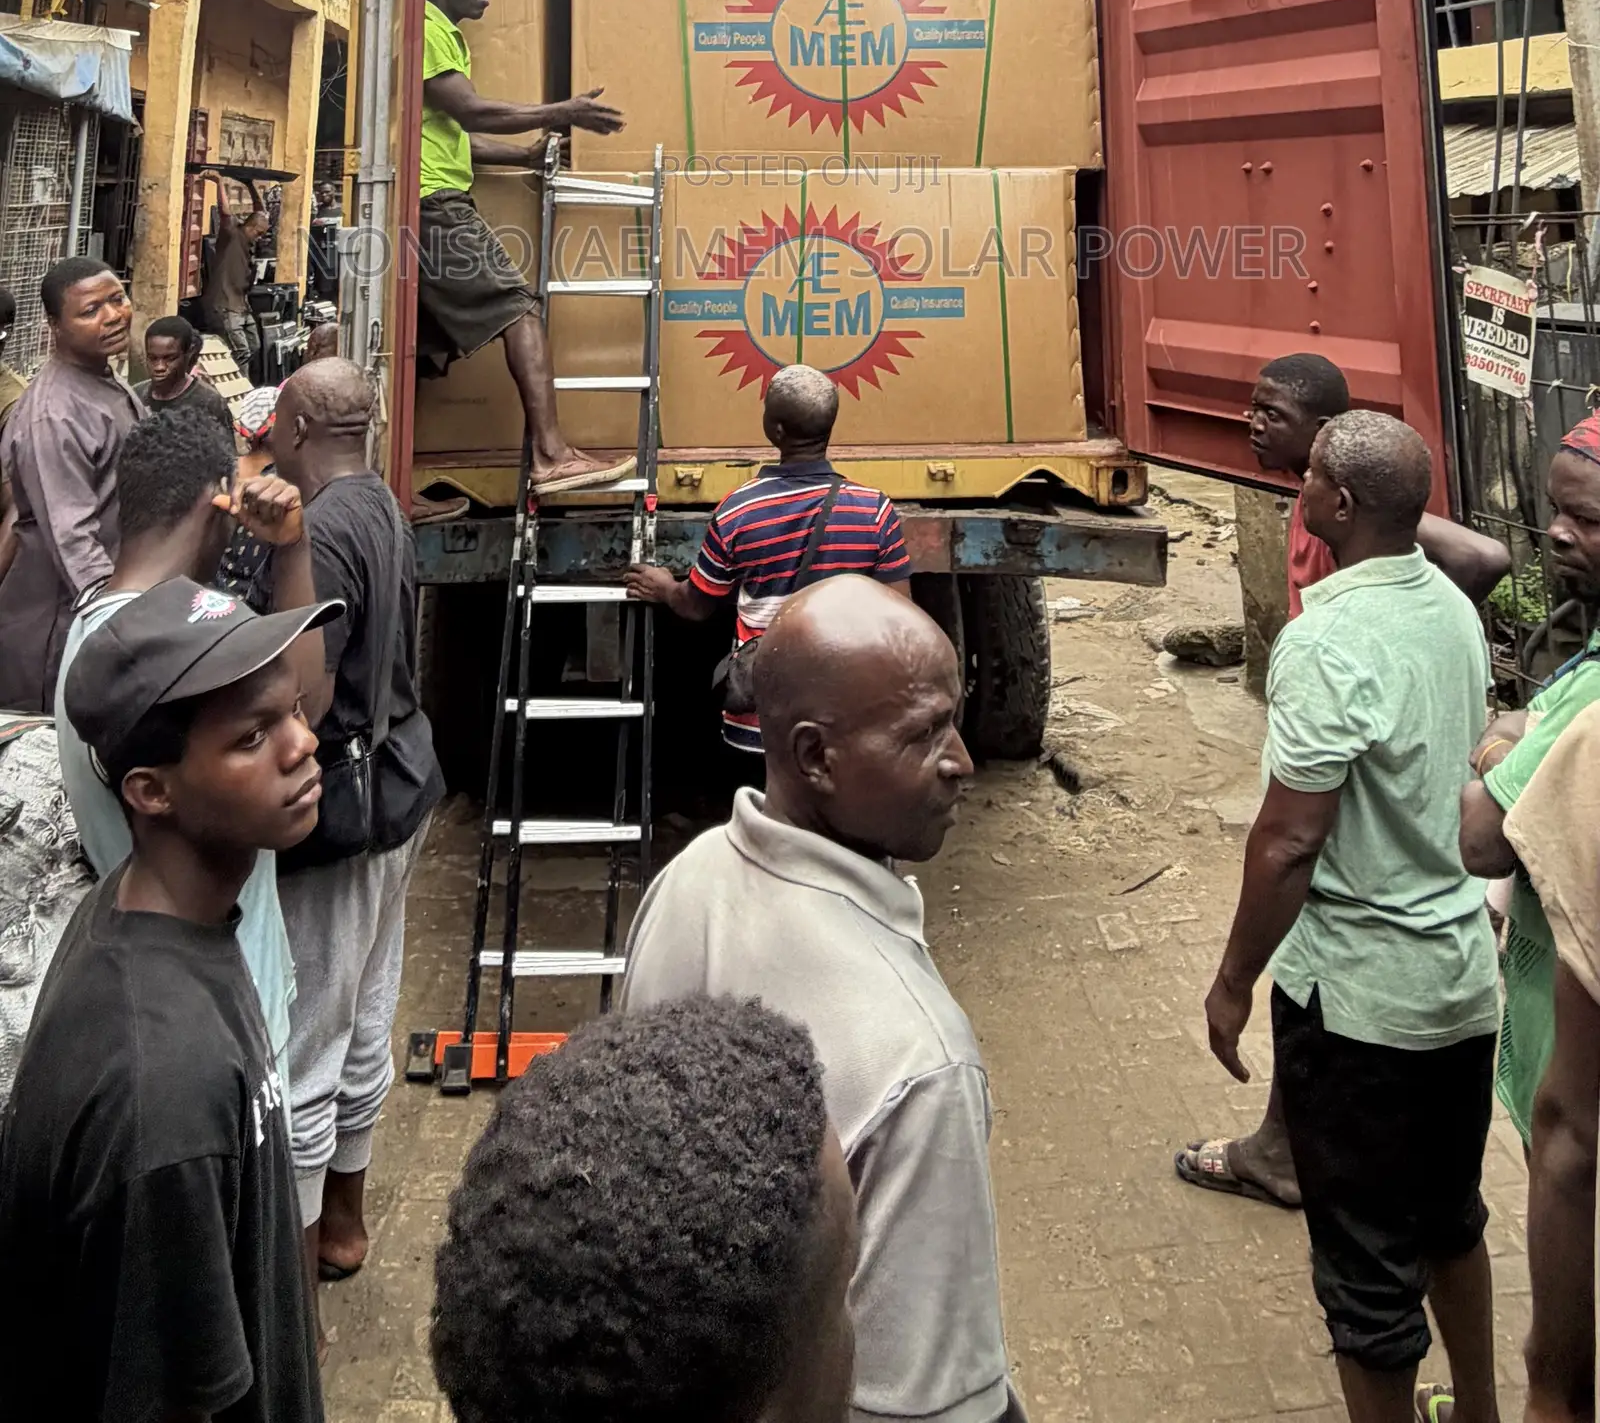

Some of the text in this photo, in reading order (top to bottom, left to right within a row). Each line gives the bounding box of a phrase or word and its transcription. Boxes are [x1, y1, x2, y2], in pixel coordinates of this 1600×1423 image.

[698, 30, 767, 49] Quality People
[789, 22, 896, 67] MEM
[912, 27, 943, 44] Quality
[891, 296, 920, 312] Quality
[1464, 280, 1532, 314] SECRETARY
[668, 299, 738, 317] Quality People
[761, 289, 872, 337] MEM
[1491, 306, 1506, 326] IS
[1464, 341, 1520, 368] ele/Whatsapp
